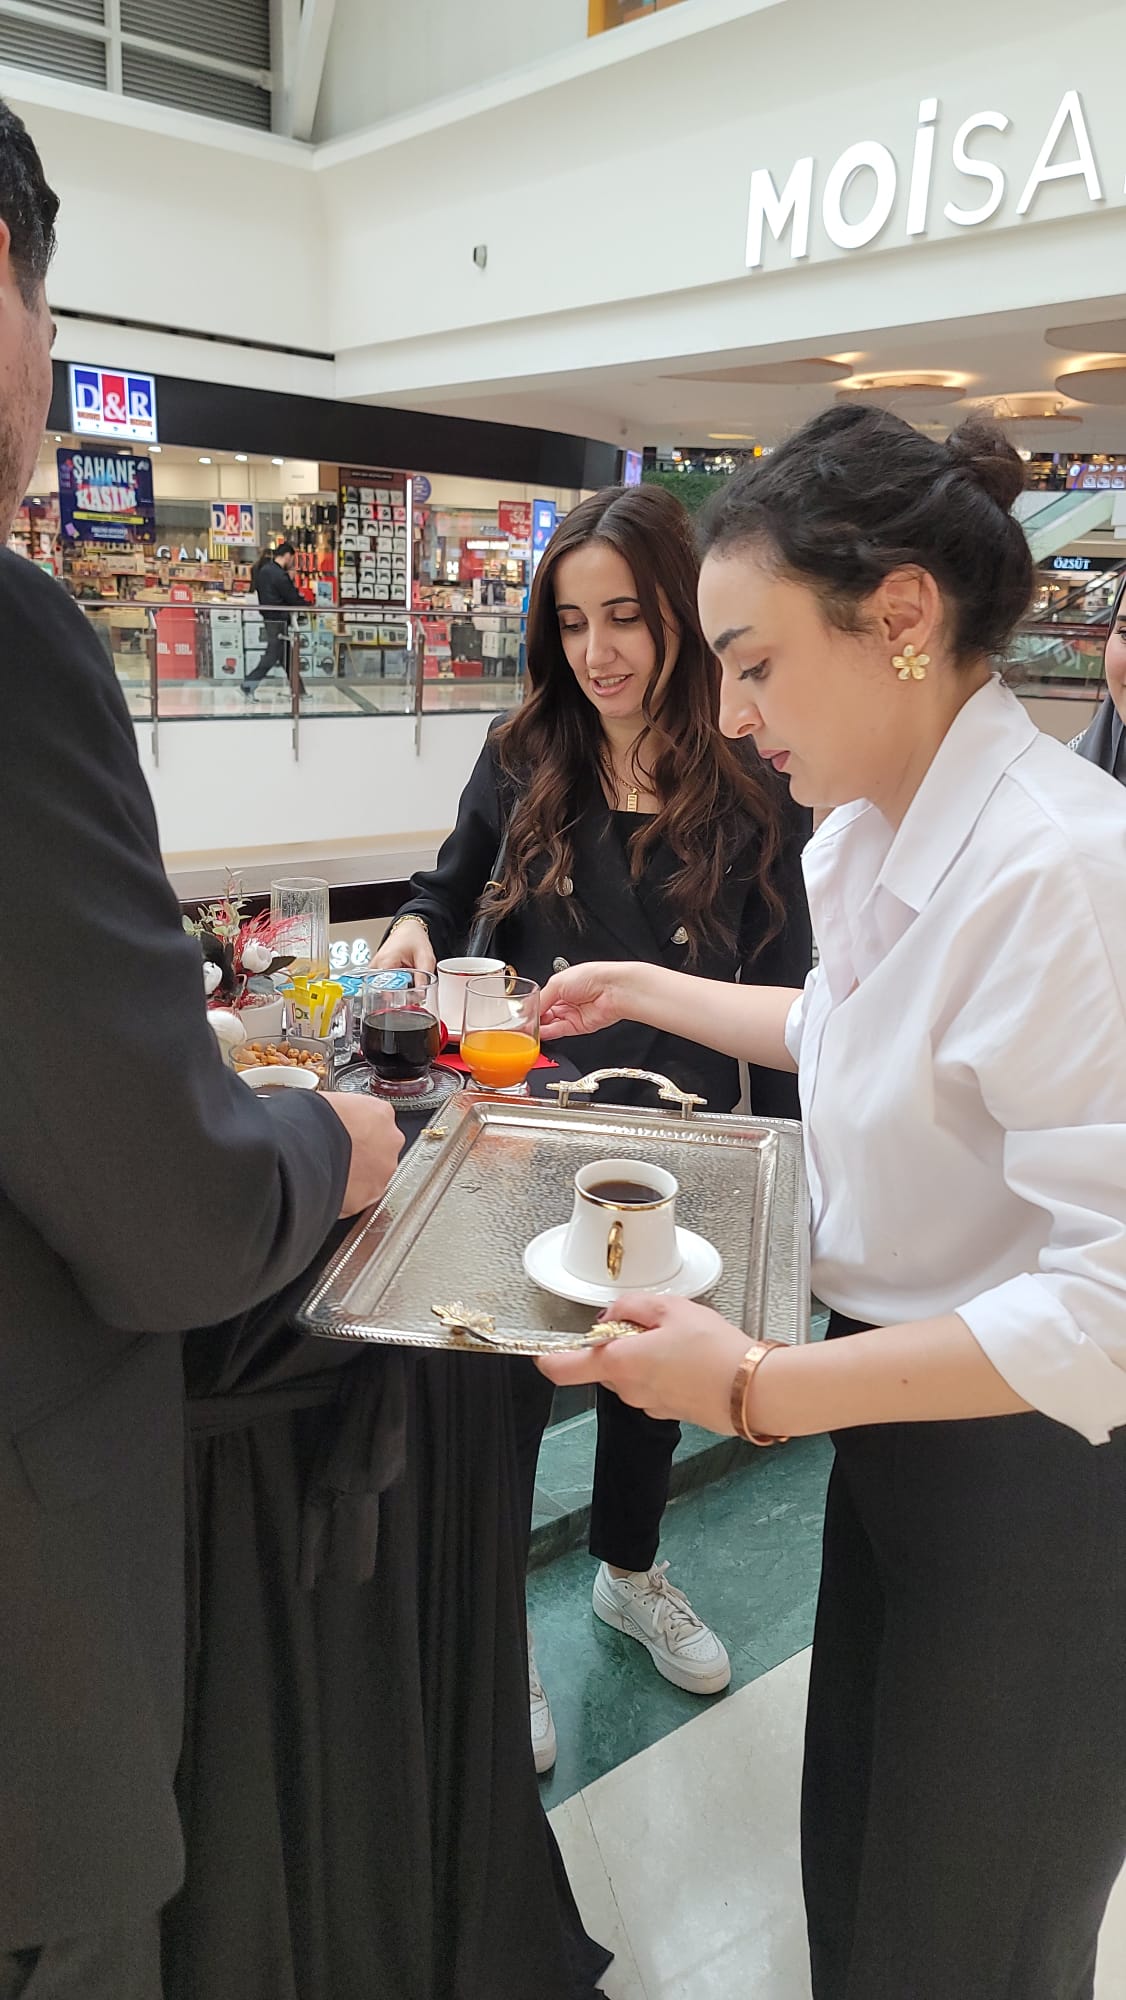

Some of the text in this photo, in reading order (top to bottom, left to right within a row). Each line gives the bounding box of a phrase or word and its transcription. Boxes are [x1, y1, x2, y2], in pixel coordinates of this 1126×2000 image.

[745, 90, 1126, 268] MOİSA
[76, 382, 152, 421] D&R
[72, 455, 136, 485] ŞAHANE
[76, 485, 137, 513] KASIM
[211, 510, 254, 534] D&R
[1053, 555, 1091, 570] ÖZSÜT
